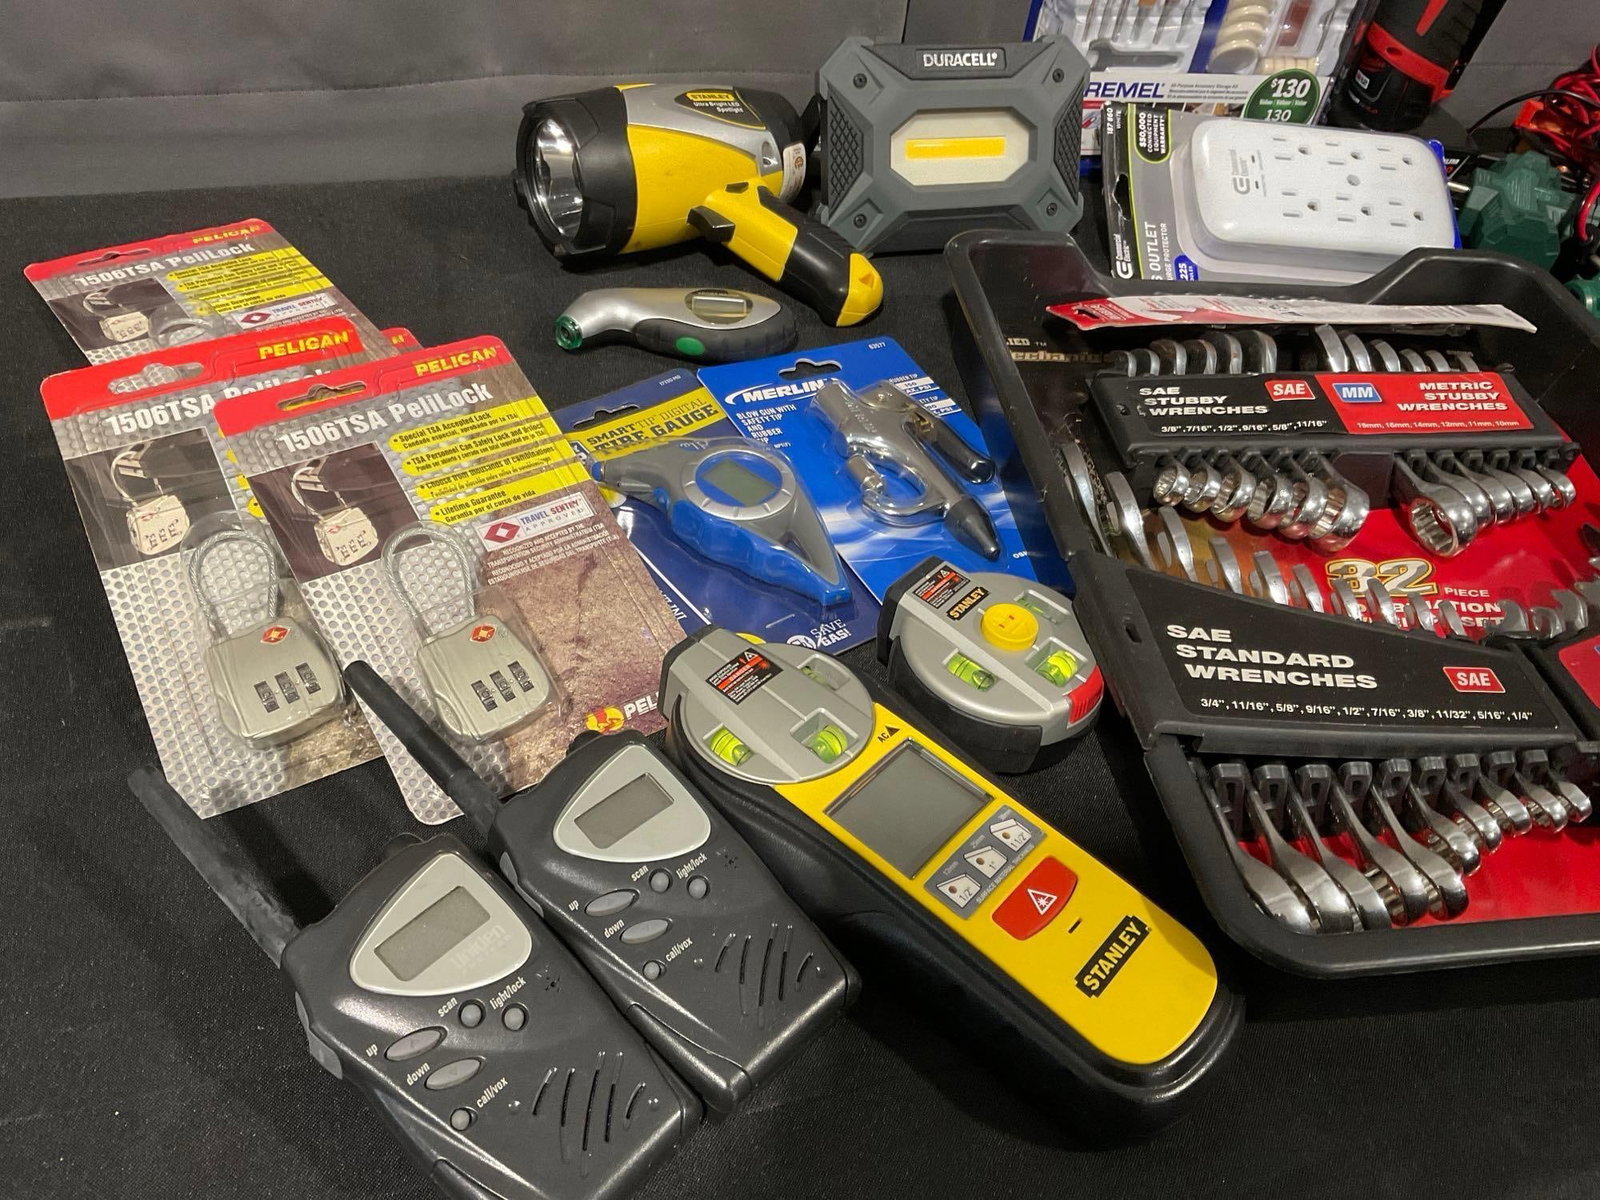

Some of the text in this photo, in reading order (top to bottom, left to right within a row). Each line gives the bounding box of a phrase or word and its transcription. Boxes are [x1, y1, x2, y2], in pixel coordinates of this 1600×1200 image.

[923, 52, 995, 67] DURACELL
[1084, 82, 1165, 98] REMEL
[1271, 78, 1311, 98] $130
[1139, 112, 1147, 148] $50,000
[193, 225, 260, 244] PELICAN
[1144, 221, 1161, 272] OUTLET
[1160, 222, 1173, 280] URGE PROTECTOR
[76, 260, 165, 287] 1506TSA
[165, 242, 256, 268] PeliLock
[259, 331, 349, 360] PELICAN
[415, 346, 498, 377] PELICAN
[743, 380, 825, 403] MERLIN
[1139, 386, 1180, 396] SAE
[1273, 383, 1306, 396] SAE
[1342, 387, 1373, 399] MM
[1419, 381, 1494, 391] METRIC
[1424, 391, 1500, 401] STUBBY
[655, 398, 707, 424] DIGITAL
[736, 403, 796, 420] BLOW GUN WITH
[1144, 395, 1228, 406] STUBBY
[1149, 405, 1269, 416] WRENCHES
[1397, 402, 1508, 411] WRENCHES
[106, 394, 216, 436] 1506TSA
[278, 383, 493, 452] 1506TSA PeliLock
[651, 403, 720, 438] GAUGE
[741, 413, 783, 426] SAFETY TIP
[400, 412, 492, 443] Special TSA Accepted Lock
[747, 423, 764, 432] AND
[751, 427, 783, 439] RUBBER
[411, 455, 426, 466] TSA
[426, 444, 459, 461] Personnel
[459, 440, 474, 451] Can
[474, 434, 494, 448] Safely
[495, 431, 511, 442] Lock
[511, 427, 524, 438] and
[439, 498, 470, 516] Lifetime
[471, 489, 506, 510] Guarantee
[519, 499, 580, 526] TRAVEL SENTRY
[525, 507, 585, 532] APPROVED
[1325, 557, 1438, 598] 32
[949, 588, 985, 618] STANLEY
[1444, 587, 1489, 598] PIECE
[810, 618, 847, 639] SAVE
[821, 628, 852, 647] GAS!
[1167, 624, 1232, 643] SAE
[1176, 644, 1354, 668] STANDARD
[1185, 663, 1378, 689] WRENCHES
[1456, 672, 1491, 687] SAE
[623, 692, 659, 720] PEL
[877, 730, 890, 743] AC
[630, 864, 649, 882] scan
[676, 852, 708, 880] light/lock
[568, 899, 580, 912] up
[603, 919, 625, 939] down
[665, 937, 693, 962] call/vox
[1083, 921, 1143, 990] STANLEY
[489, 976, 527, 1010] light/lock
[437, 997, 458, 1017] scan
[365, 1043, 379, 1058] up
[406, 1062, 431, 1087] down
[476, 1076, 509, 1109] call/vox
